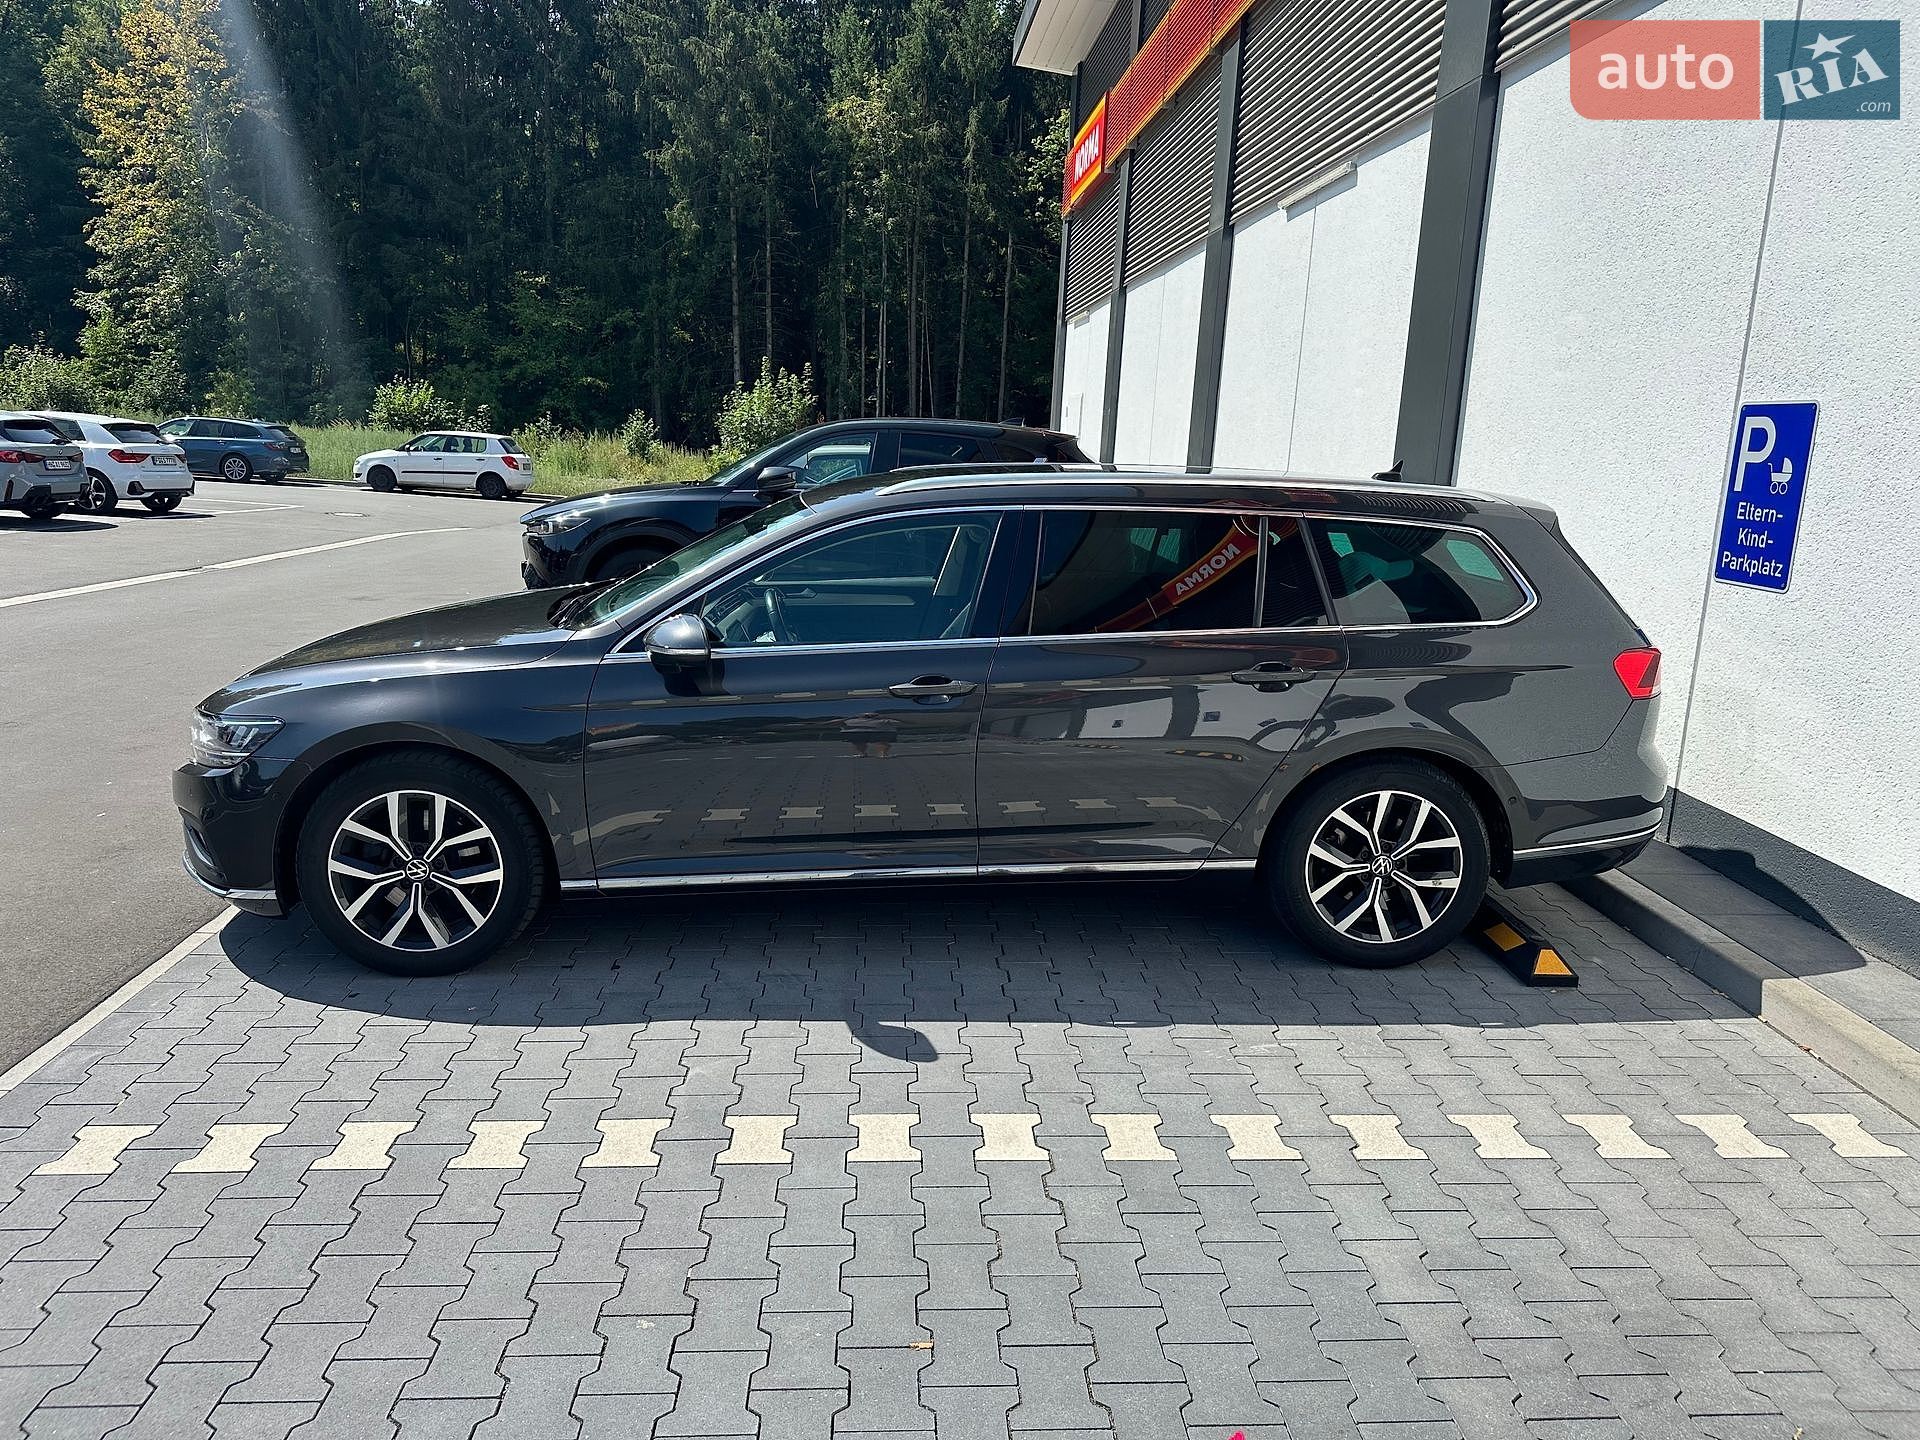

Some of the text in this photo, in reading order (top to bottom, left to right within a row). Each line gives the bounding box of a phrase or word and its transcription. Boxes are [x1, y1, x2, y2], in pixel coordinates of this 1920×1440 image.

[1074, 123, 1100, 184] NORMA
[1734, 416, 1776, 491] P
[1736, 502, 1783, 523] Eltern-
[1737, 527, 1774, 548] Kind-
[1721, 551, 1784, 577] Parkplatz
